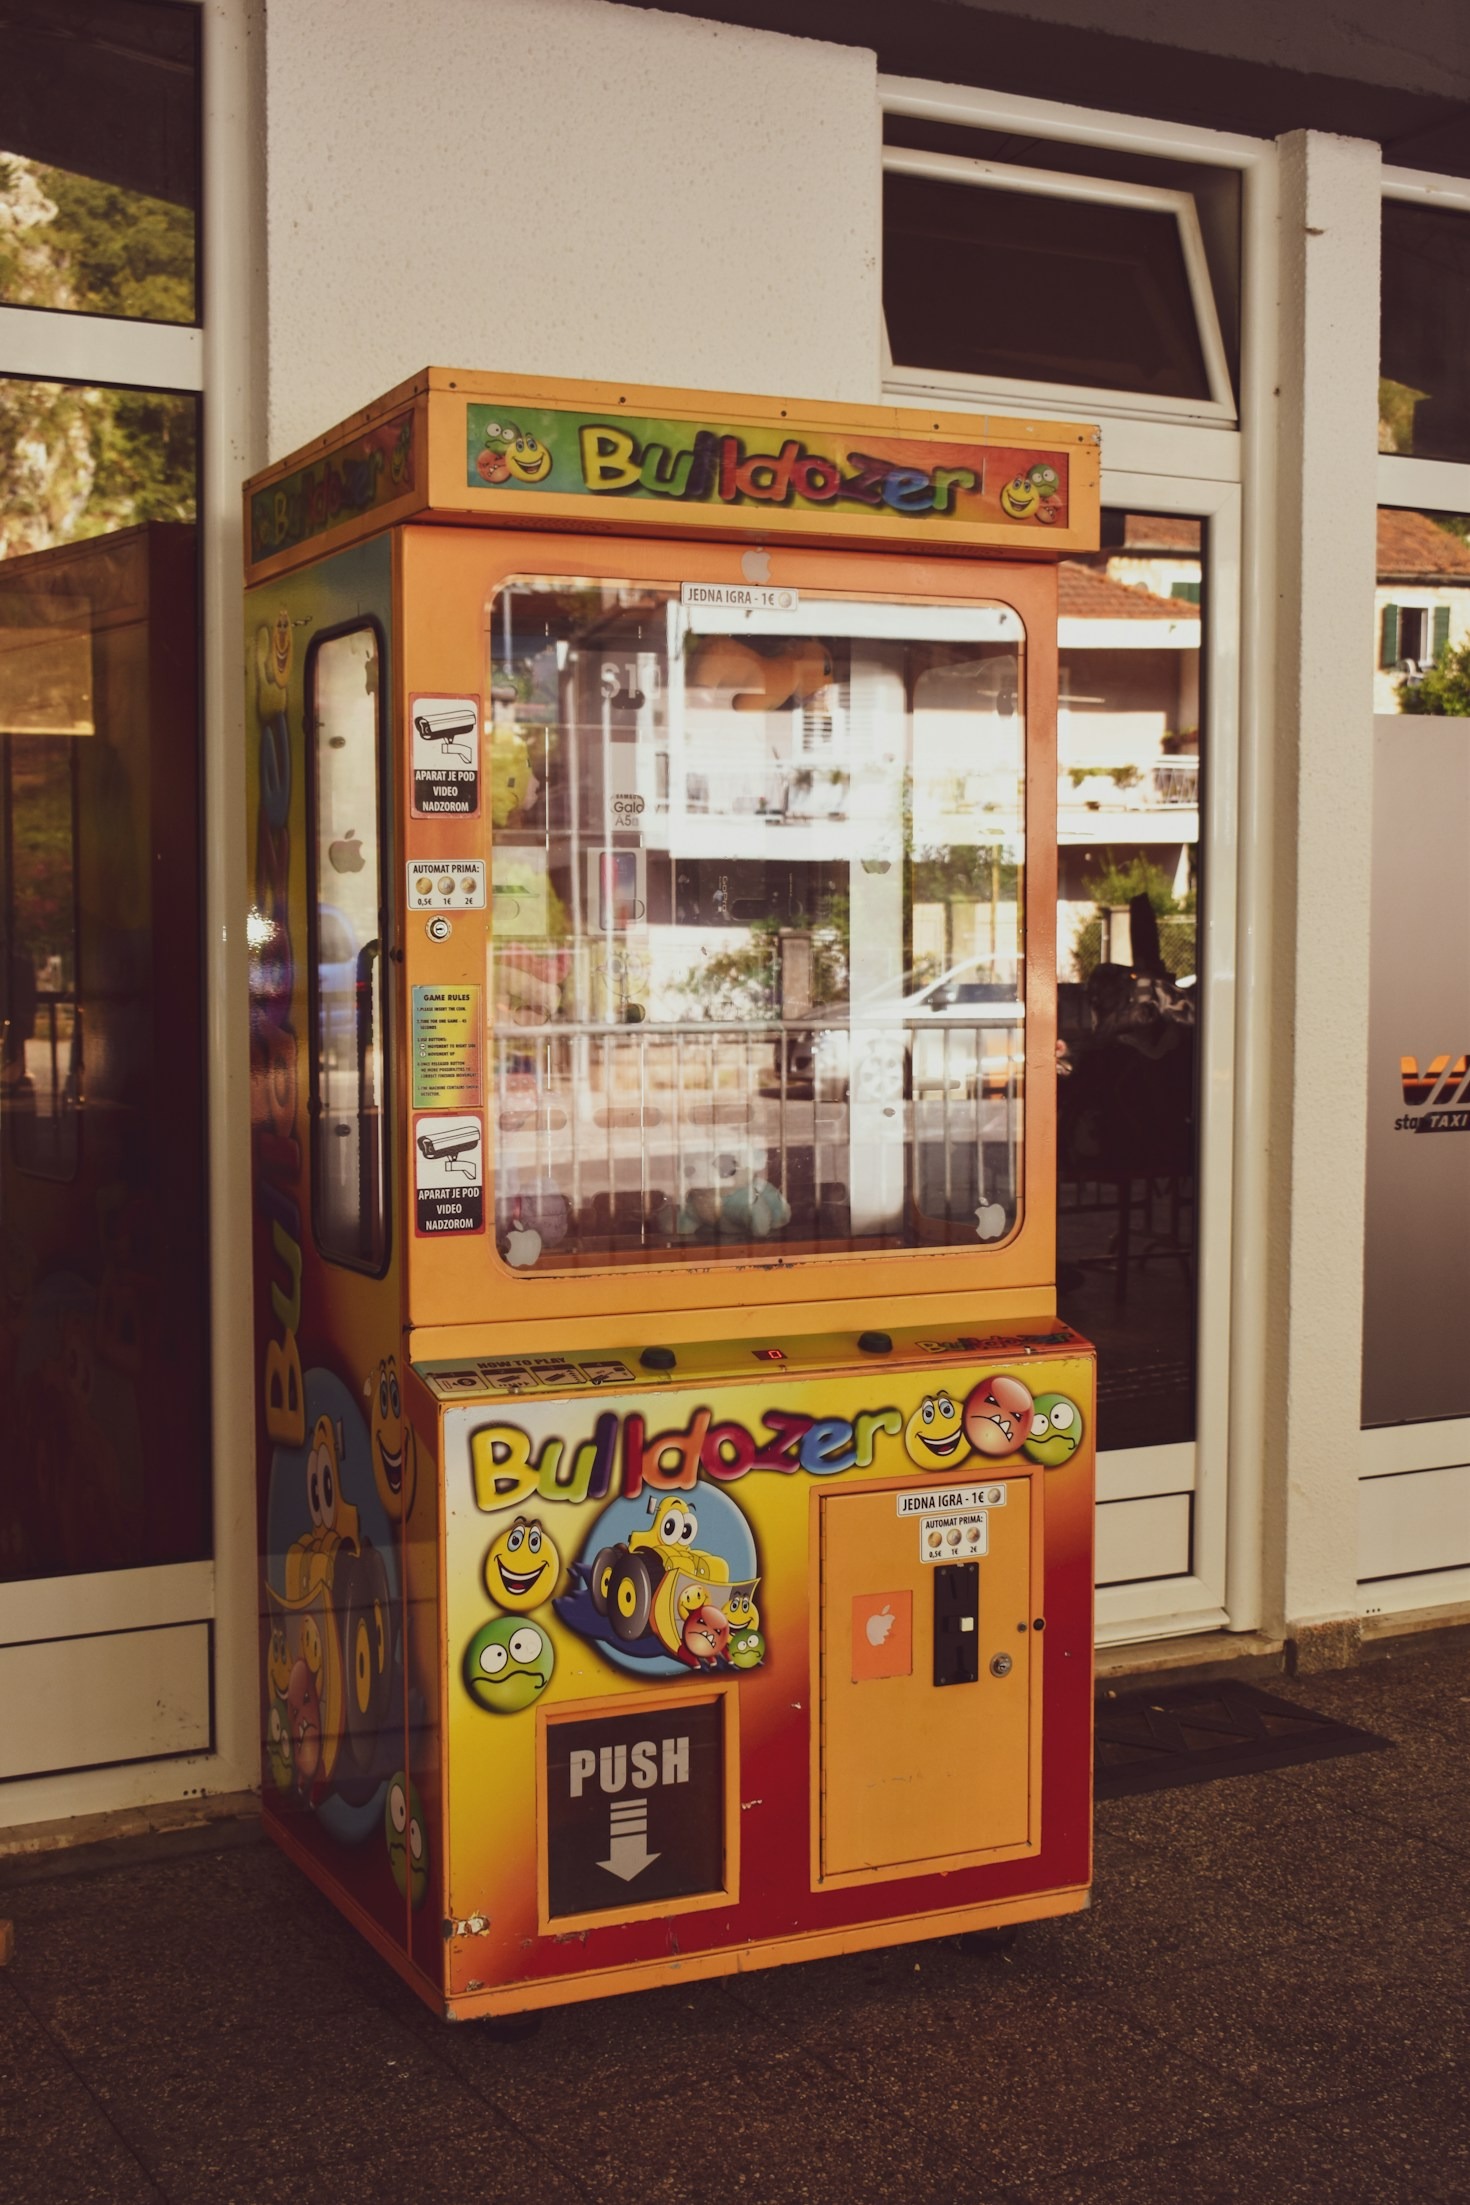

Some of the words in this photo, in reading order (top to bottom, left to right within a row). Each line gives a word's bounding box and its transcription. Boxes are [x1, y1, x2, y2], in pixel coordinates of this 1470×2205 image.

[579, 424, 977, 516] Bulldozer
[688, 588, 722, 602] JEDNA
[726, 590, 751, 604] IGRA
[762, 593, 774, 605] 1€
[415, 771, 447, 781] APARAT
[448, 771, 457, 781] JE
[458, 771, 475, 781] POD
[433, 786, 458, 796] VIDEO
[422, 801, 469, 812] NADZOROM
[413, 865, 450, 873] AUTOMAT
[451, 864, 479, 873] PRIMA:
[1430, 1114, 1468, 1128] TAXI
[418, 1189, 450, 1200] APARAT
[451, 1188, 460, 1198] JE
[462, 1187, 479, 1198] POD
[436, 1203, 462, 1214] VIDEO
[425, 1218, 473, 1230] NADZOROM
[533, 1357, 566, 1365] PLAY
[471, 1405, 901, 1511] Bulldozer
[903, 1496, 935, 1511] JEDNA
[938, 1494, 963, 1507] IGRA
[972, 1491, 984, 1504] 1€
[925, 1518, 957, 1529] AUTOMAT
[959, 1515, 983, 1525] PRIMA:
[929, 1550, 942, 1558] 0,5€
[569, 1736, 691, 1798] PUSH
